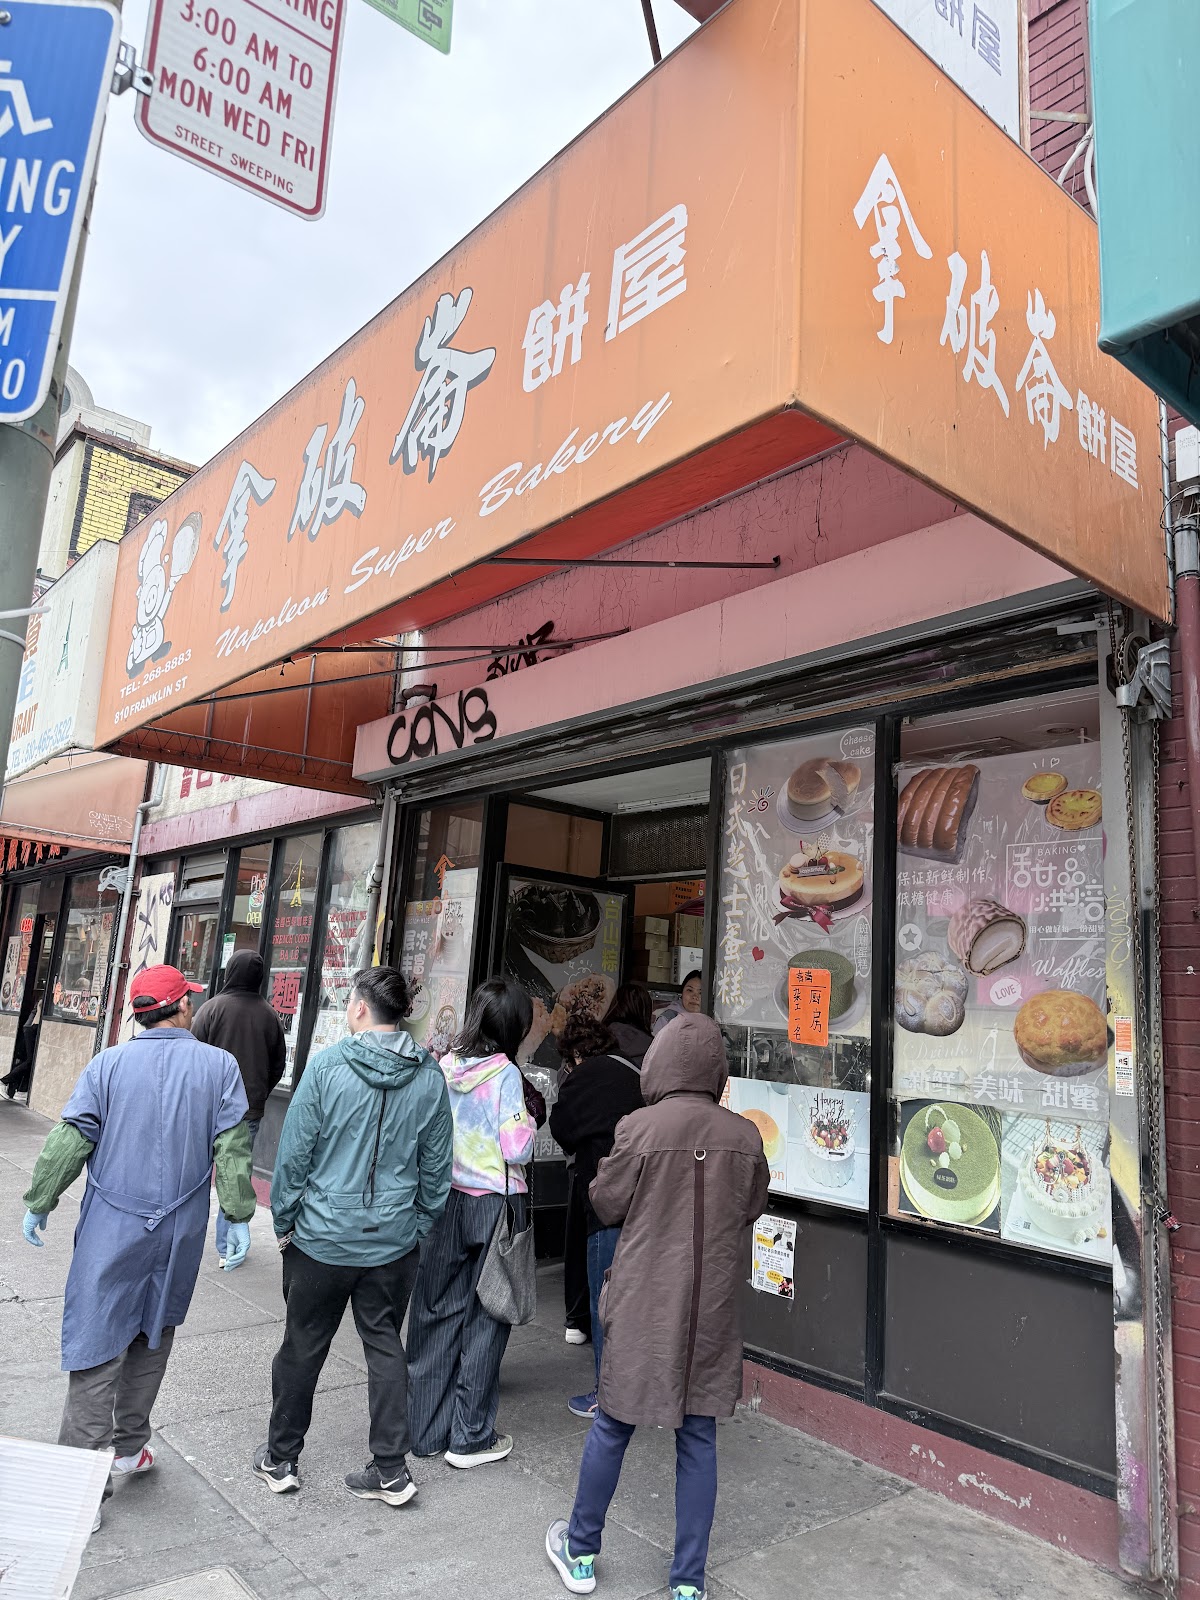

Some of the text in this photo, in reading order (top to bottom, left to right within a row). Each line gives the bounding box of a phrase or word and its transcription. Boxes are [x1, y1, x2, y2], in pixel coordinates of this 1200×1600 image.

[180, 0, 313, 89] 3:00 AM TO
[193, 47, 293, 119] 6:00 AM
[159, 66, 315, 172] MON WED FRI
[174, 125, 294, 194] STREET SWEEPING
[215, 391, 673, 659] Napoleon Super Bakery
[120, 648, 192, 699] TEL: 268-8883
[114, 675, 189, 725] 810 FRANKLIN ST
[843, 734, 874, 746] cheese
[850, 745, 871, 757] cake
[1012, 847, 1086, 888] 甜品
[1037, 846, 1077, 857] BAKING
[717, 762, 751, 1008] 日式芝士蛋糕
[897, 888, 954, 907] 低糖健康
[1033, 878, 1104, 922] 烘焙
[994, 984, 1017, 1000] LOVE
[1031, 956, 1106, 989] Waffles
[813, 1092, 845, 1114] Happy
[973, 1074, 1023, 1103] 美味
[1041, 1080, 1099, 1111] 甜蜜
